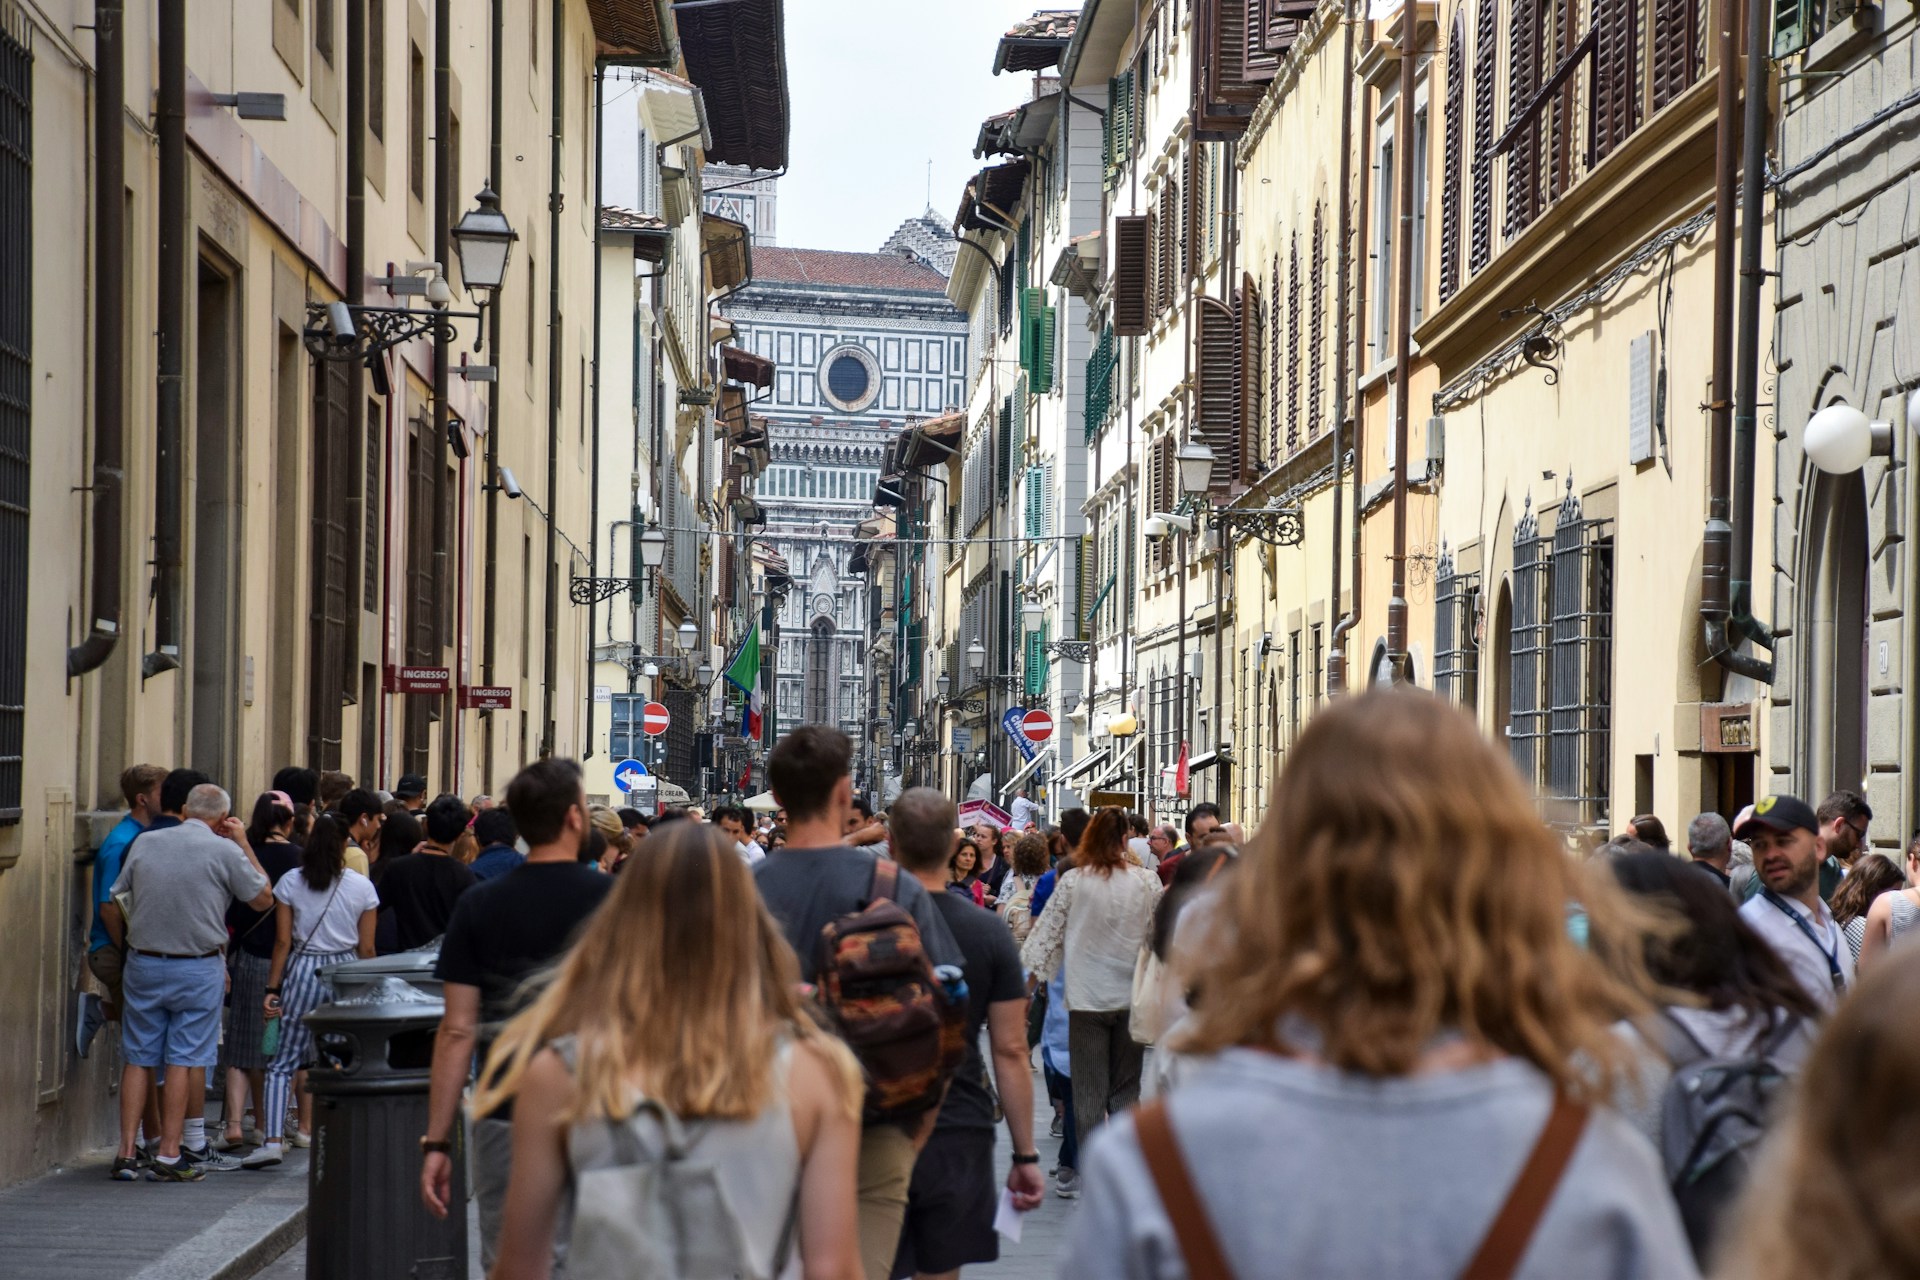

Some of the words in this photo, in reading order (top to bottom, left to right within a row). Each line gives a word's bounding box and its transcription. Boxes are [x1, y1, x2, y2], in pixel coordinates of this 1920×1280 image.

[403, 670, 448, 679] INGRESSO
[472, 689, 511, 697] INGRESSO
[1004, 720, 1015, 734] BOOK
